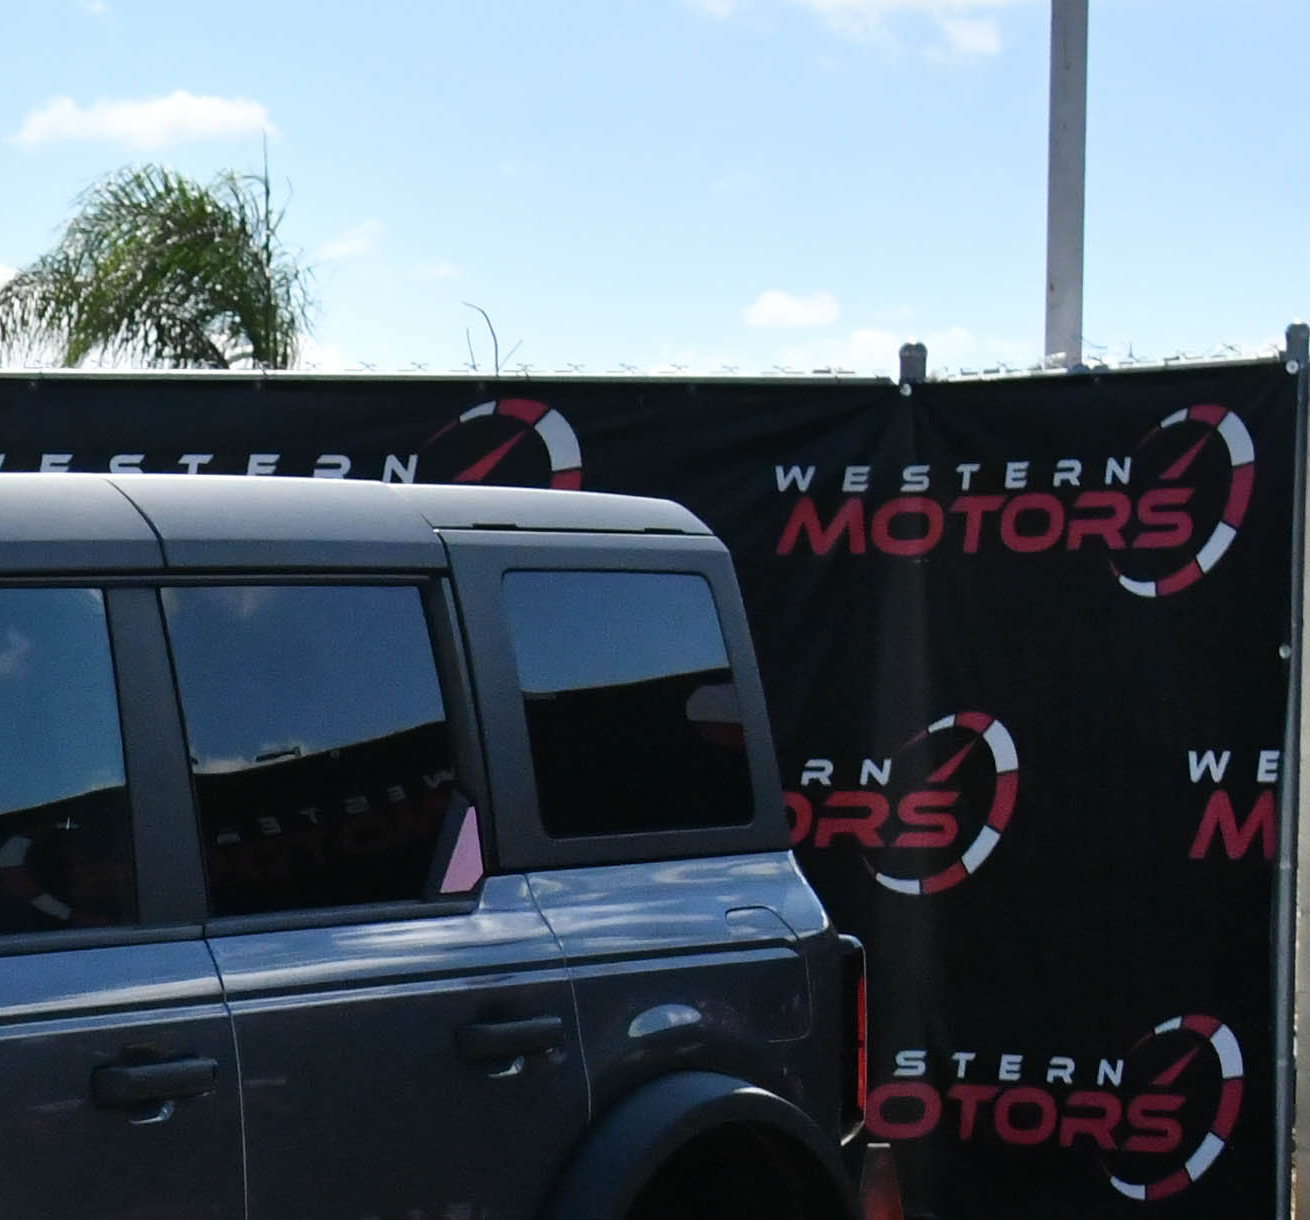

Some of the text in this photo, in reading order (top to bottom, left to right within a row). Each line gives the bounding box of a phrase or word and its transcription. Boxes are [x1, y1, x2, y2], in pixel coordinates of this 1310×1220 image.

[775, 457, 1132, 492] WESTERN
[778, 487, 1194, 556] MOTORS
[893, 1050, 1125, 1086] STERN
[866, 1082, 1185, 1153] OTORS
